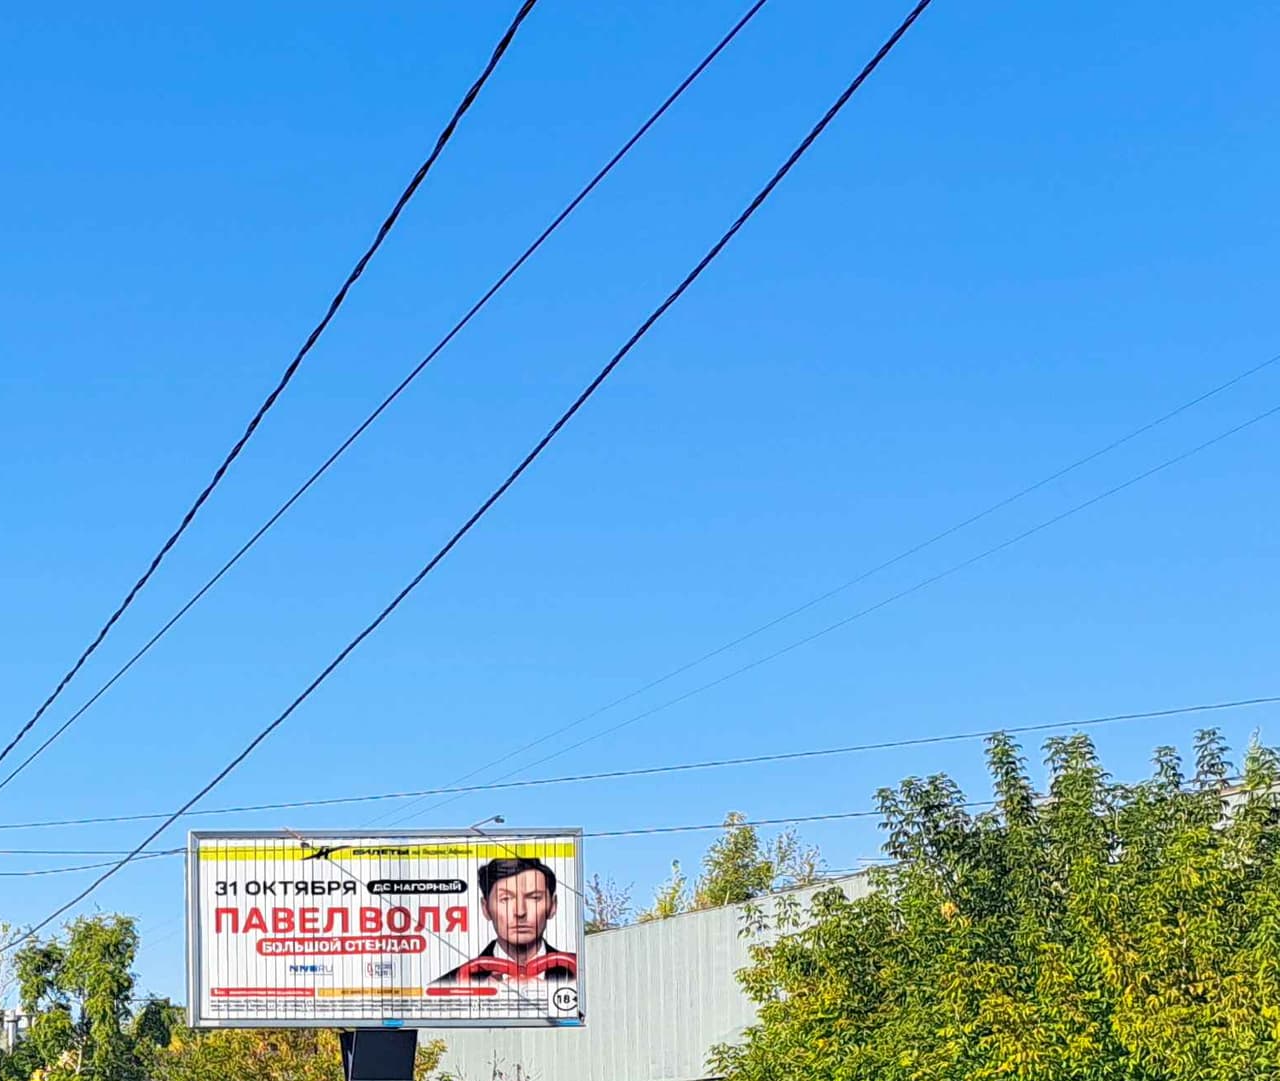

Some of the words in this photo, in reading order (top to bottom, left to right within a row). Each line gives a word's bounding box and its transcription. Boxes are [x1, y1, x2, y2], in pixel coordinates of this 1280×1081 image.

[215, 881, 237, 896] 31
[245, 880, 357, 896] ОКТЯБРЯ
[372, 883, 391, 892] ДС
[393, 880, 462, 891] НАГОРНЫЙ
[214, 906, 350, 934] ПАВЕЛ
[359, 906, 469, 933] ВОЛЯ
[261, 937, 341, 954] БОЛЬШОЙ
[344, 938, 421, 953] СТЕНДАП
